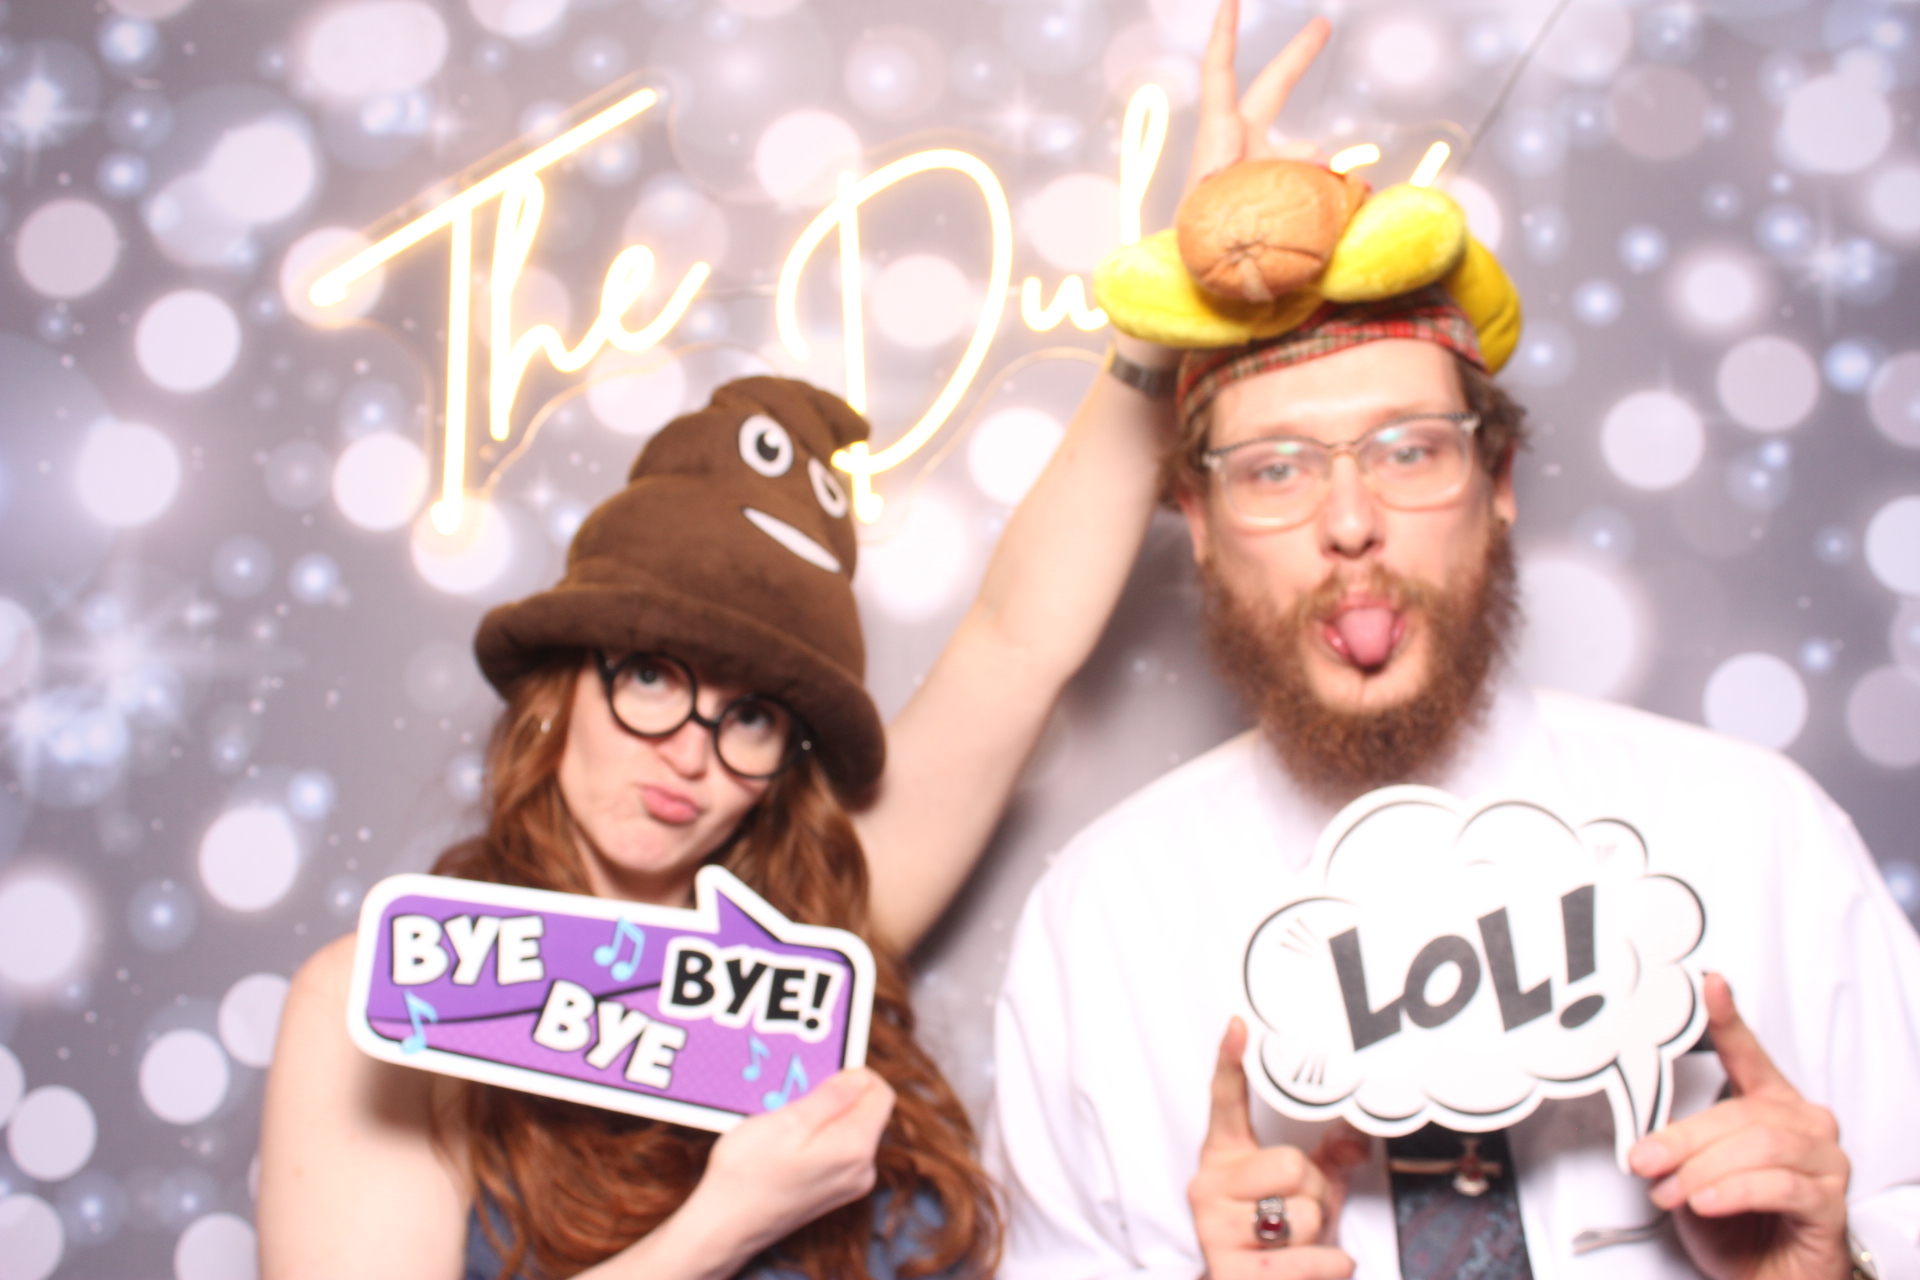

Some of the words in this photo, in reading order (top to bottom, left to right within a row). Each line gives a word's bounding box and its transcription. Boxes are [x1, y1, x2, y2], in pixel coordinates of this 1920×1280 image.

[308, 87, 712, 536] The
[391, 914, 545, 987] BYE
[670, 949, 832, 1031] BYE!
[532, 979, 687, 1091] BYE
